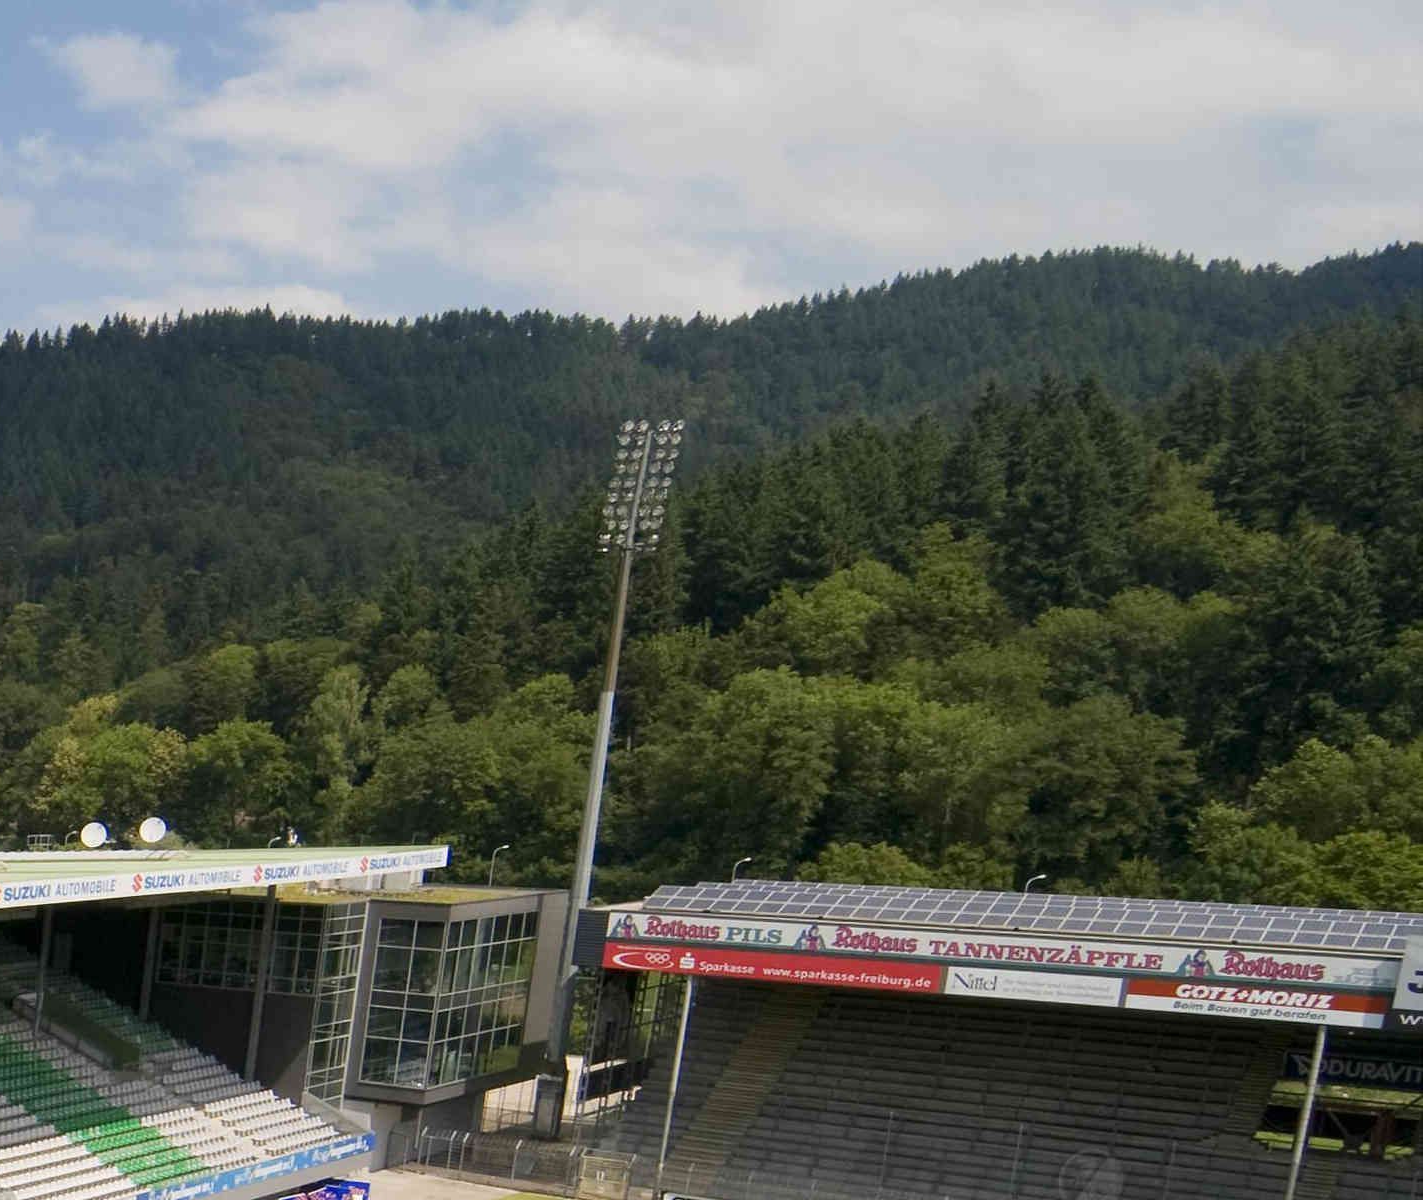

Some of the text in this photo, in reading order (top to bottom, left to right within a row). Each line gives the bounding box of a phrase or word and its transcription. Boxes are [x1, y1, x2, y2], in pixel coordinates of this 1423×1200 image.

[264, 861, 351, 880] SUZUKI AUTOMOBILE
[370, 858, 400, 870] SUZUKI
[5, 880, 117, 901] SUZUKI AUTOMOBILE
[144, 869, 242, 889] SUZUKI AUTOMOBILE
[644, 916, 783, 944] Rothaus PILS
[832, 924, 1164, 970] Rothaus TANNENZÄPFLE
[699, 961, 932, 989] Sparkasse www.sparkasse-freiburg.de
[1219, 950, 1326, 981] Rothaus
